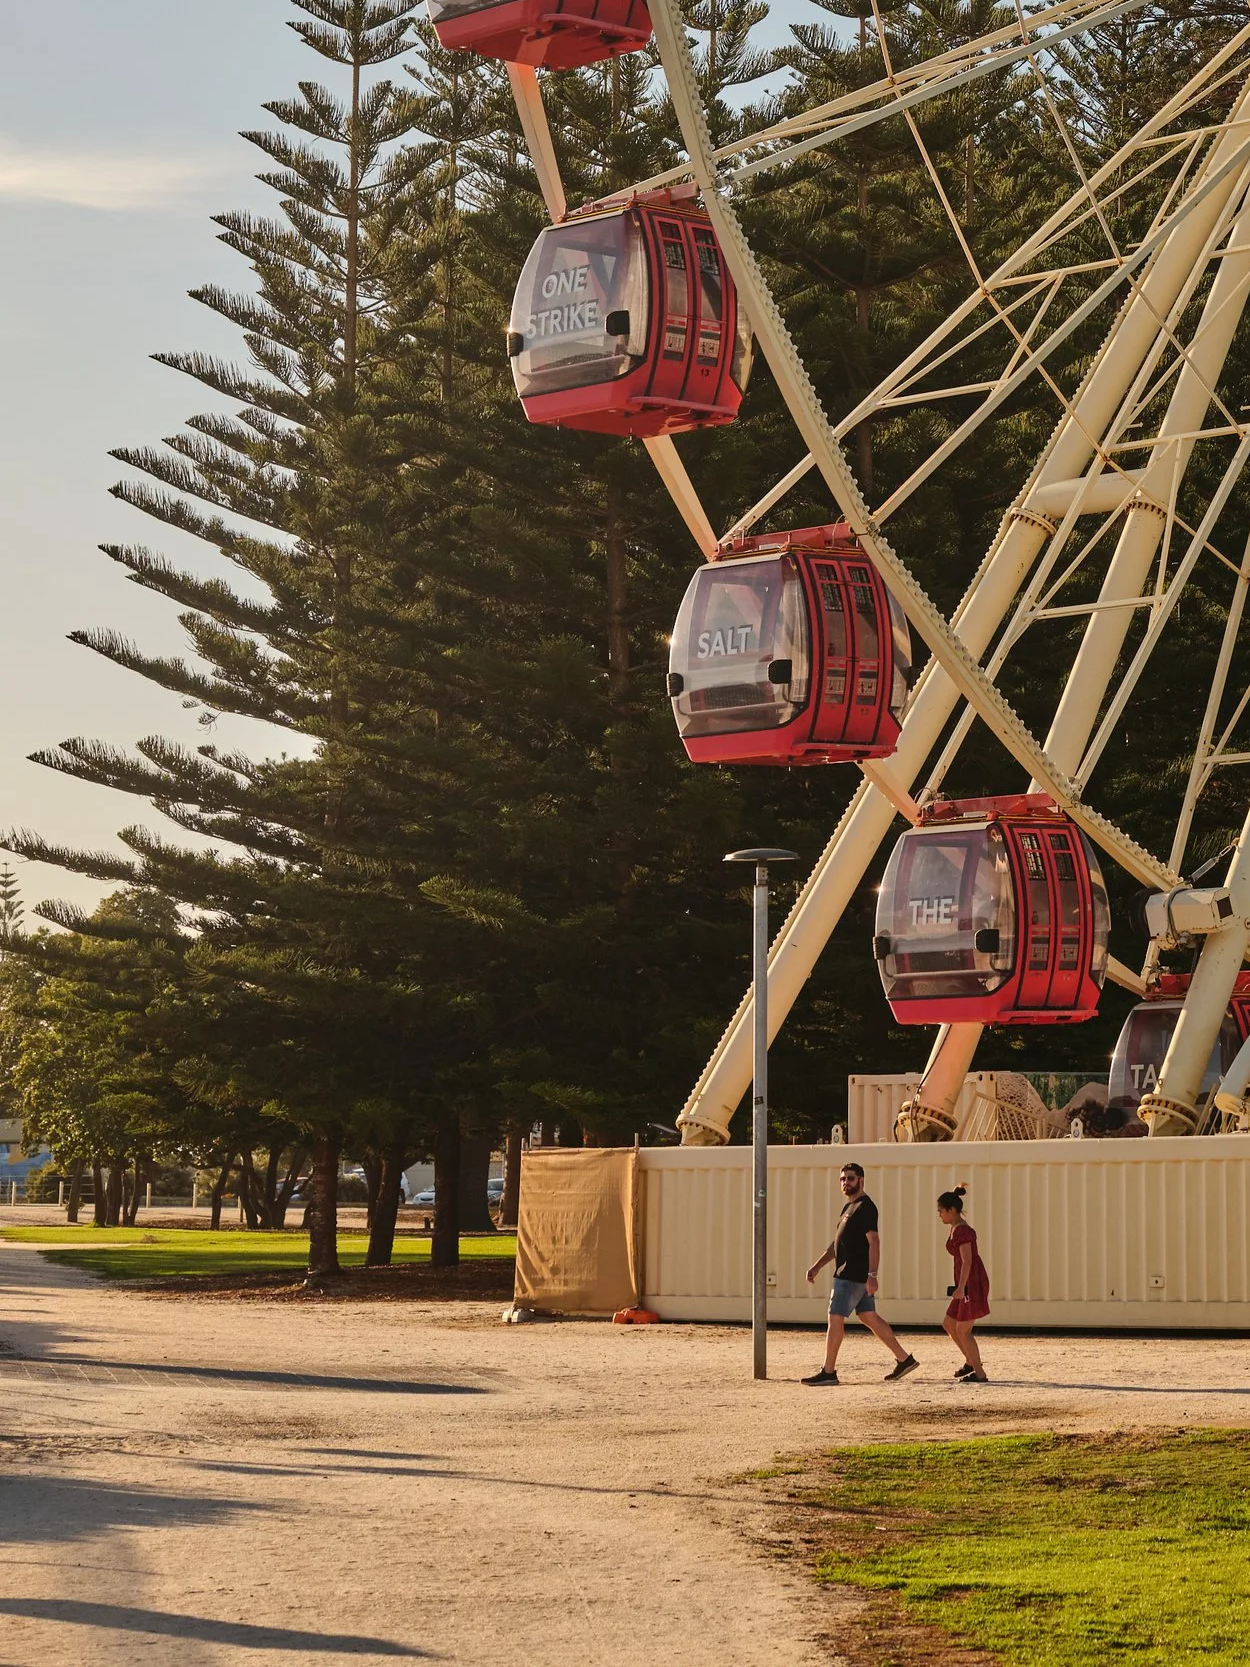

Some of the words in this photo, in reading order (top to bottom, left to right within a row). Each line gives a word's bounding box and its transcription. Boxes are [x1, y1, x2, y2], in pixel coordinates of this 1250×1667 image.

[542, 266, 589, 298] ONE
[526, 301, 598, 340] STRIKE
[700, 368, 710, 377] 13
[696, 626, 752, 659] SALT
[908, 898, 953, 926] THE
